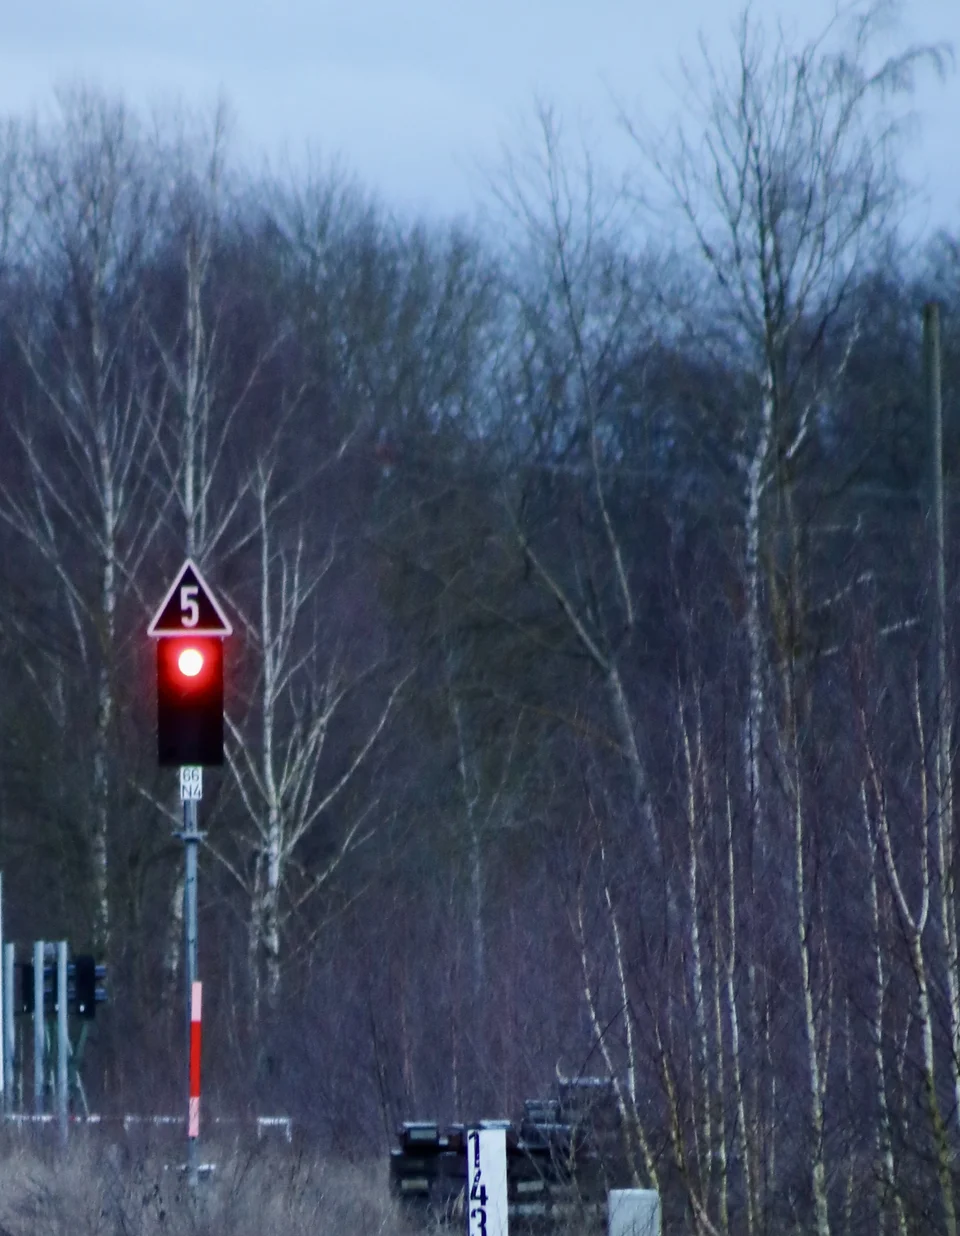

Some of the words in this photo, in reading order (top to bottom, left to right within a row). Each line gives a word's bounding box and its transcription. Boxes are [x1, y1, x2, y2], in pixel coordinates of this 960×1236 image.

[180, 585, 199, 628] 5
[183, 767, 200, 782] 66
[182, 784, 201, 799] N4
